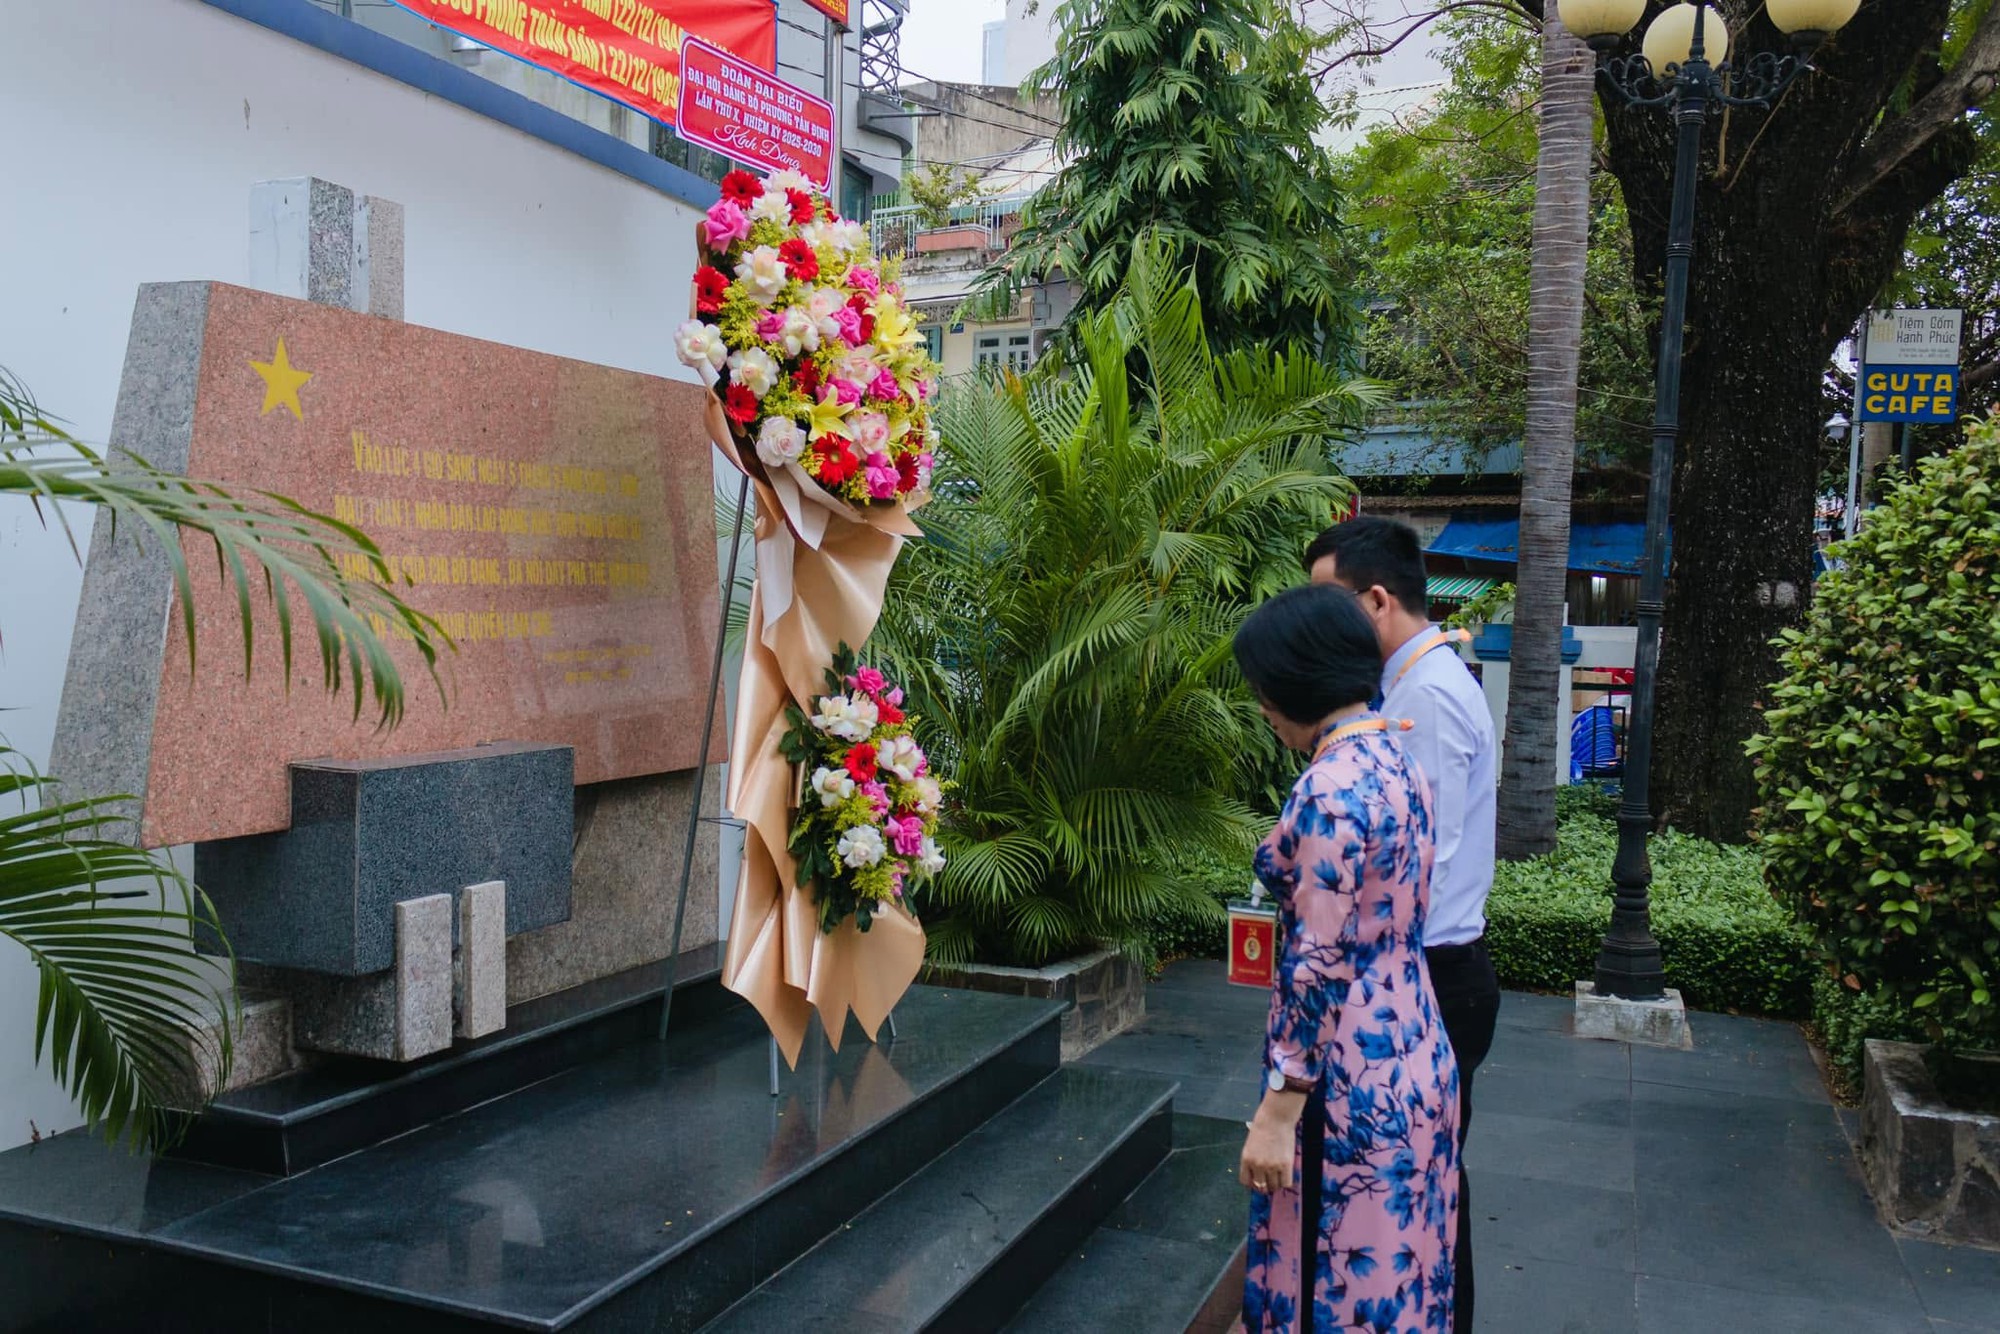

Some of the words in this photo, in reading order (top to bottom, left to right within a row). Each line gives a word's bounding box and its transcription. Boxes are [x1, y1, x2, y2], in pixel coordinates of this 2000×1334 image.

[530, 7, 568, 58] TOÀN
[567, 25, 599, 73] DÂN
[721, 63, 752, 90] ĐOÀN
[755, 80, 774, 100] ĐẠI
[777, 92, 803, 113] BIỂU
[687, 66, 704, 87] ĐẠI
[706, 74, 721, 95] HỘI
[723, 82, 746, 106] ĐẢNG
[748, 93, 759, 113] BỘ
[760, 100, 793, 126] PHƯỜNG
[794, 115, 810, 134] TÂN
[811, 123, 830, 143] ĐỊNH
[695, 90, 713, 111] LẦN
[743, 112, 770, 136] NHIỆM
[781, 129, 822, 158] 2025-2030
[713, 124, 758, 150] Kính
[1898, 316, 1924, 332] Tiệm
[1930, 315, 1954, 329] Gốm
[1929, 330, 1956, 344] Phúc
[1867, 373, 1953, 392] GUTA
[1865, 395, 1950, 415] CAFE
